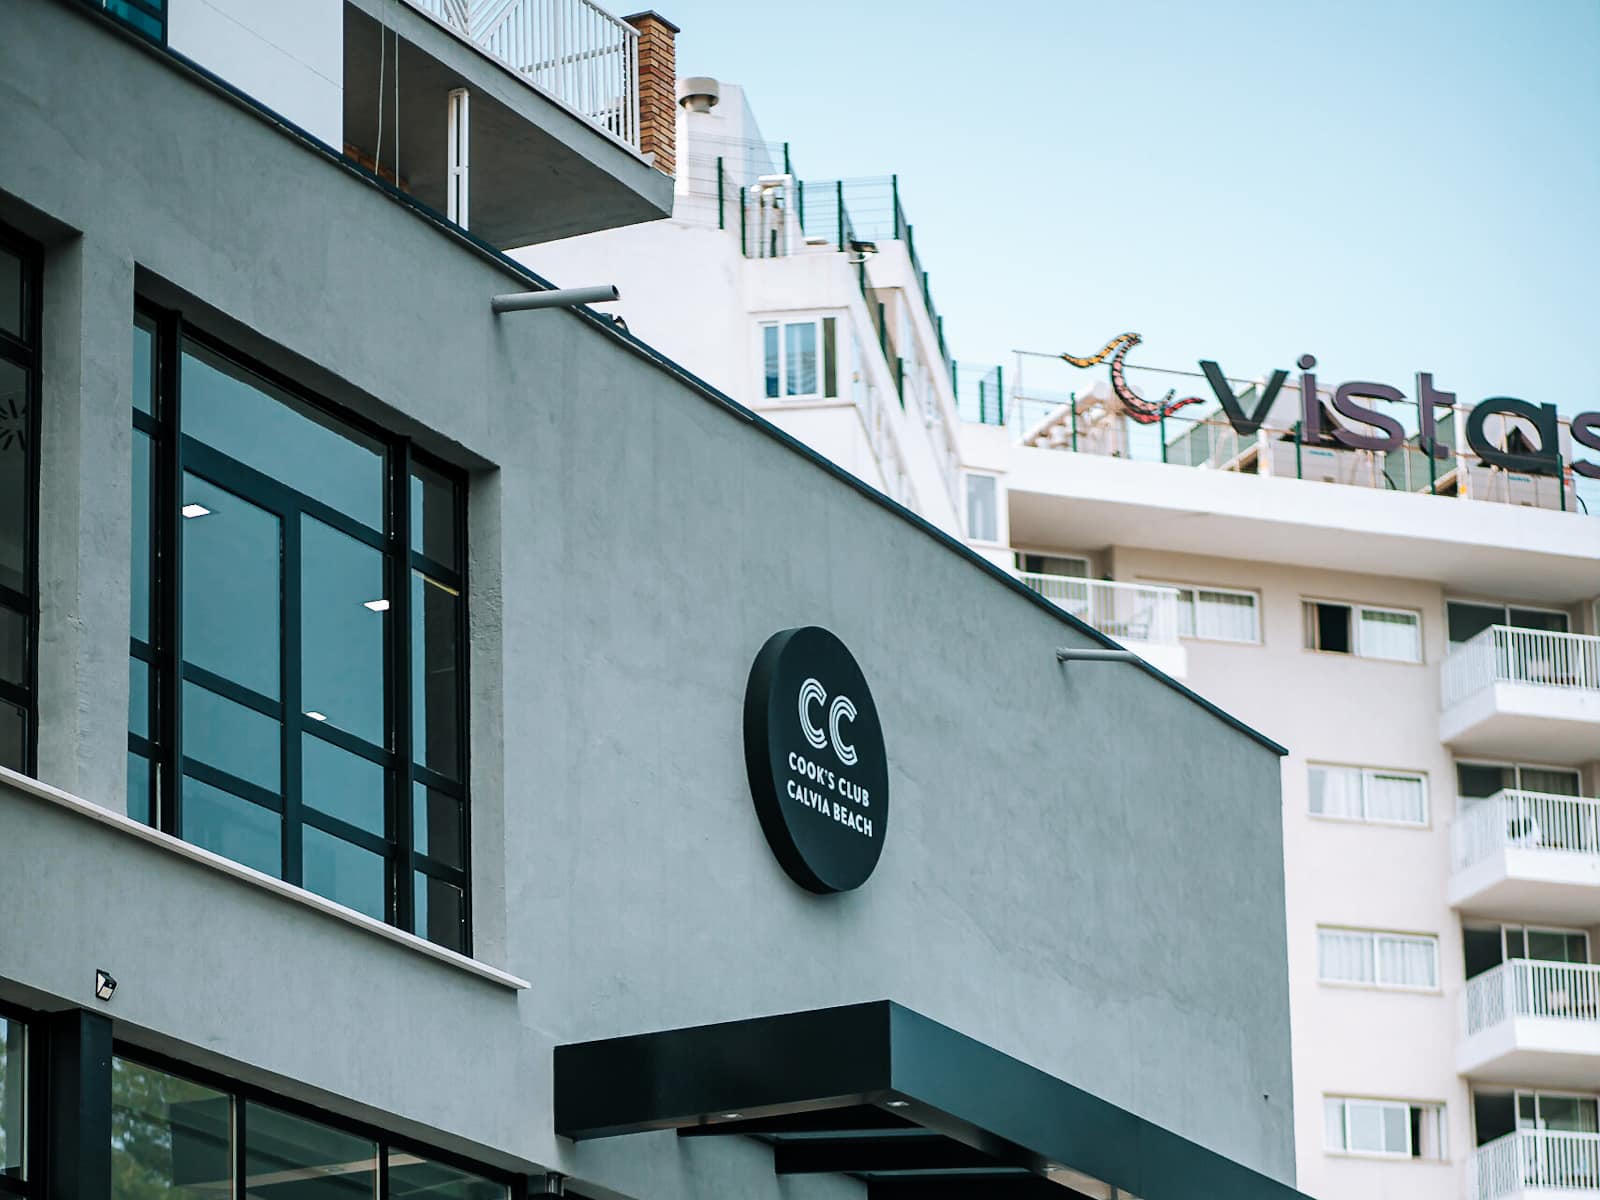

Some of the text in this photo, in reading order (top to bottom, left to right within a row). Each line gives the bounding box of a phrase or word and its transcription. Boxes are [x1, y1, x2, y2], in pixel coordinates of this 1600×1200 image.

[799, 677, 858, 766] CC
[787, 779, 873, 837] CALVIA BEACH
[788, 751, 870, 808] COOK'S CLUB
